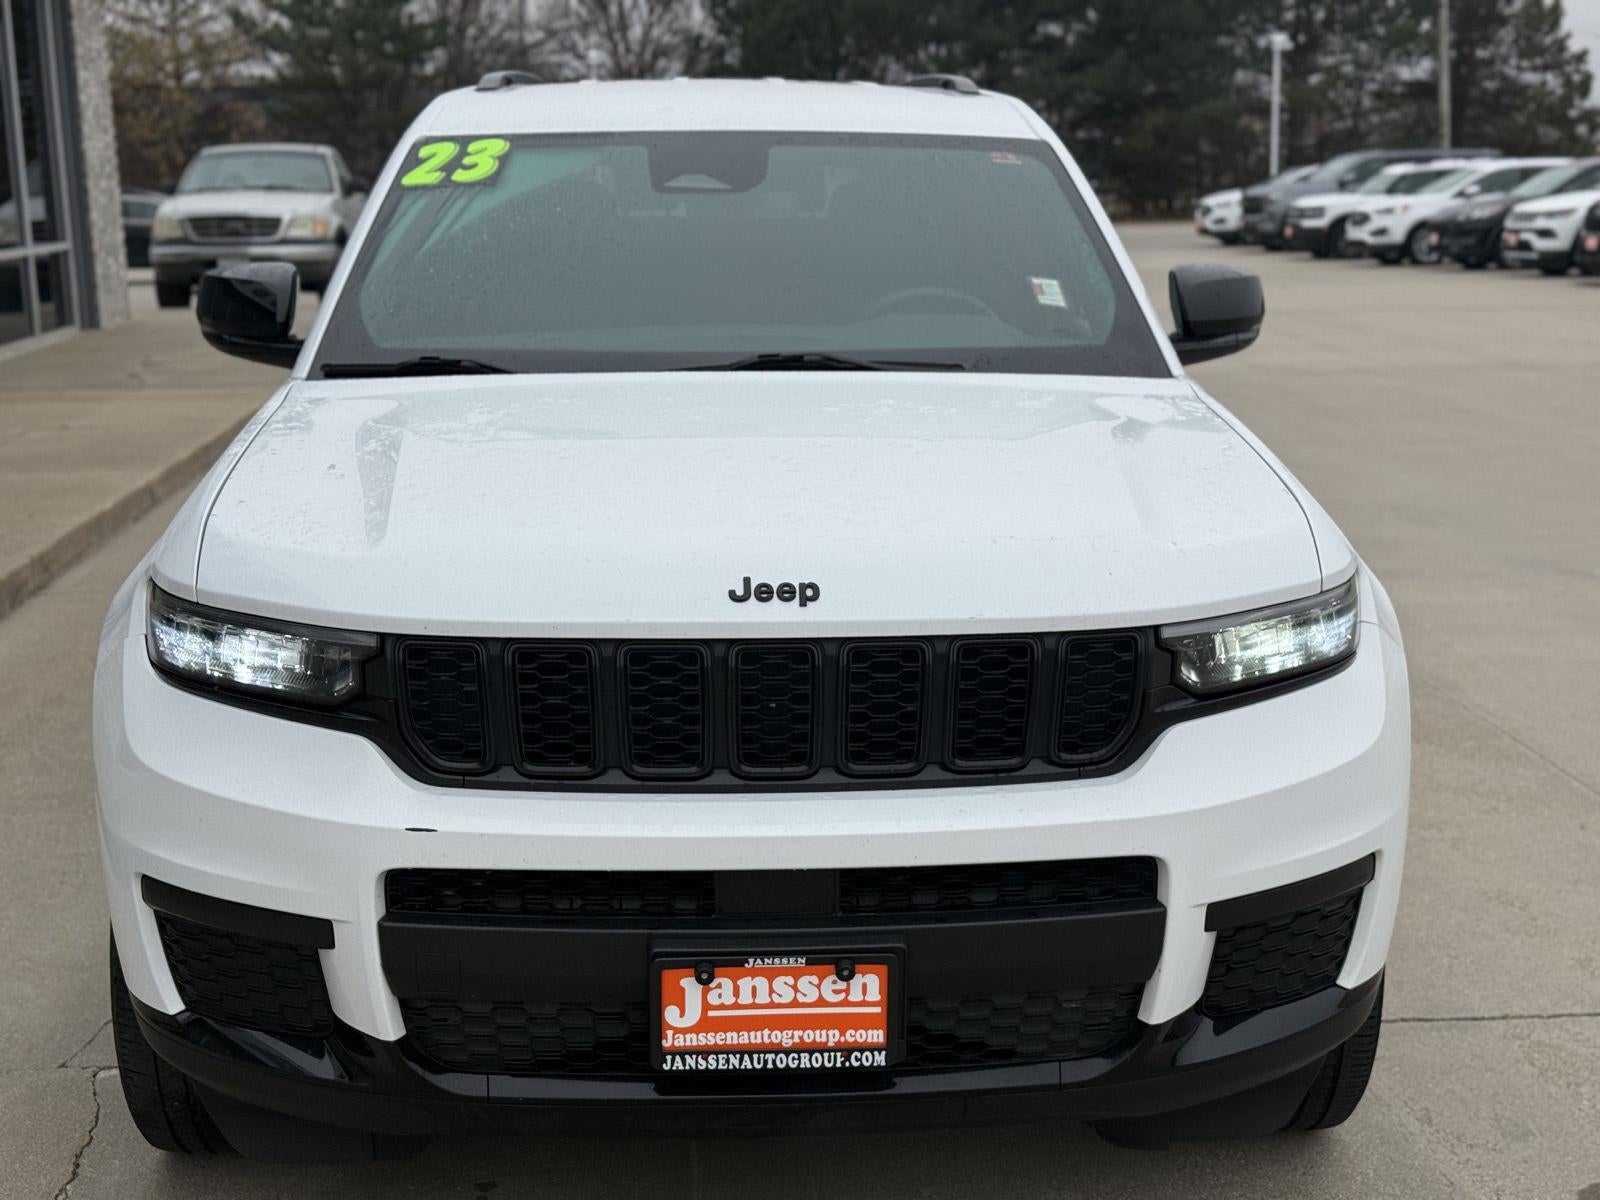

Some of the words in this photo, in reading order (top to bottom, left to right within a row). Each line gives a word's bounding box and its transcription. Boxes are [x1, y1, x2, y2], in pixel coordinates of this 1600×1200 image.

[401, 138, 510, 186] 23
[728, 576, 821, 607] Jeep
[744, 956, 806, 968] JANSSEN
[664, 973, 882, 1028] Janssen
[662, 1028, 884, 1048] Janssenautogroup.com
